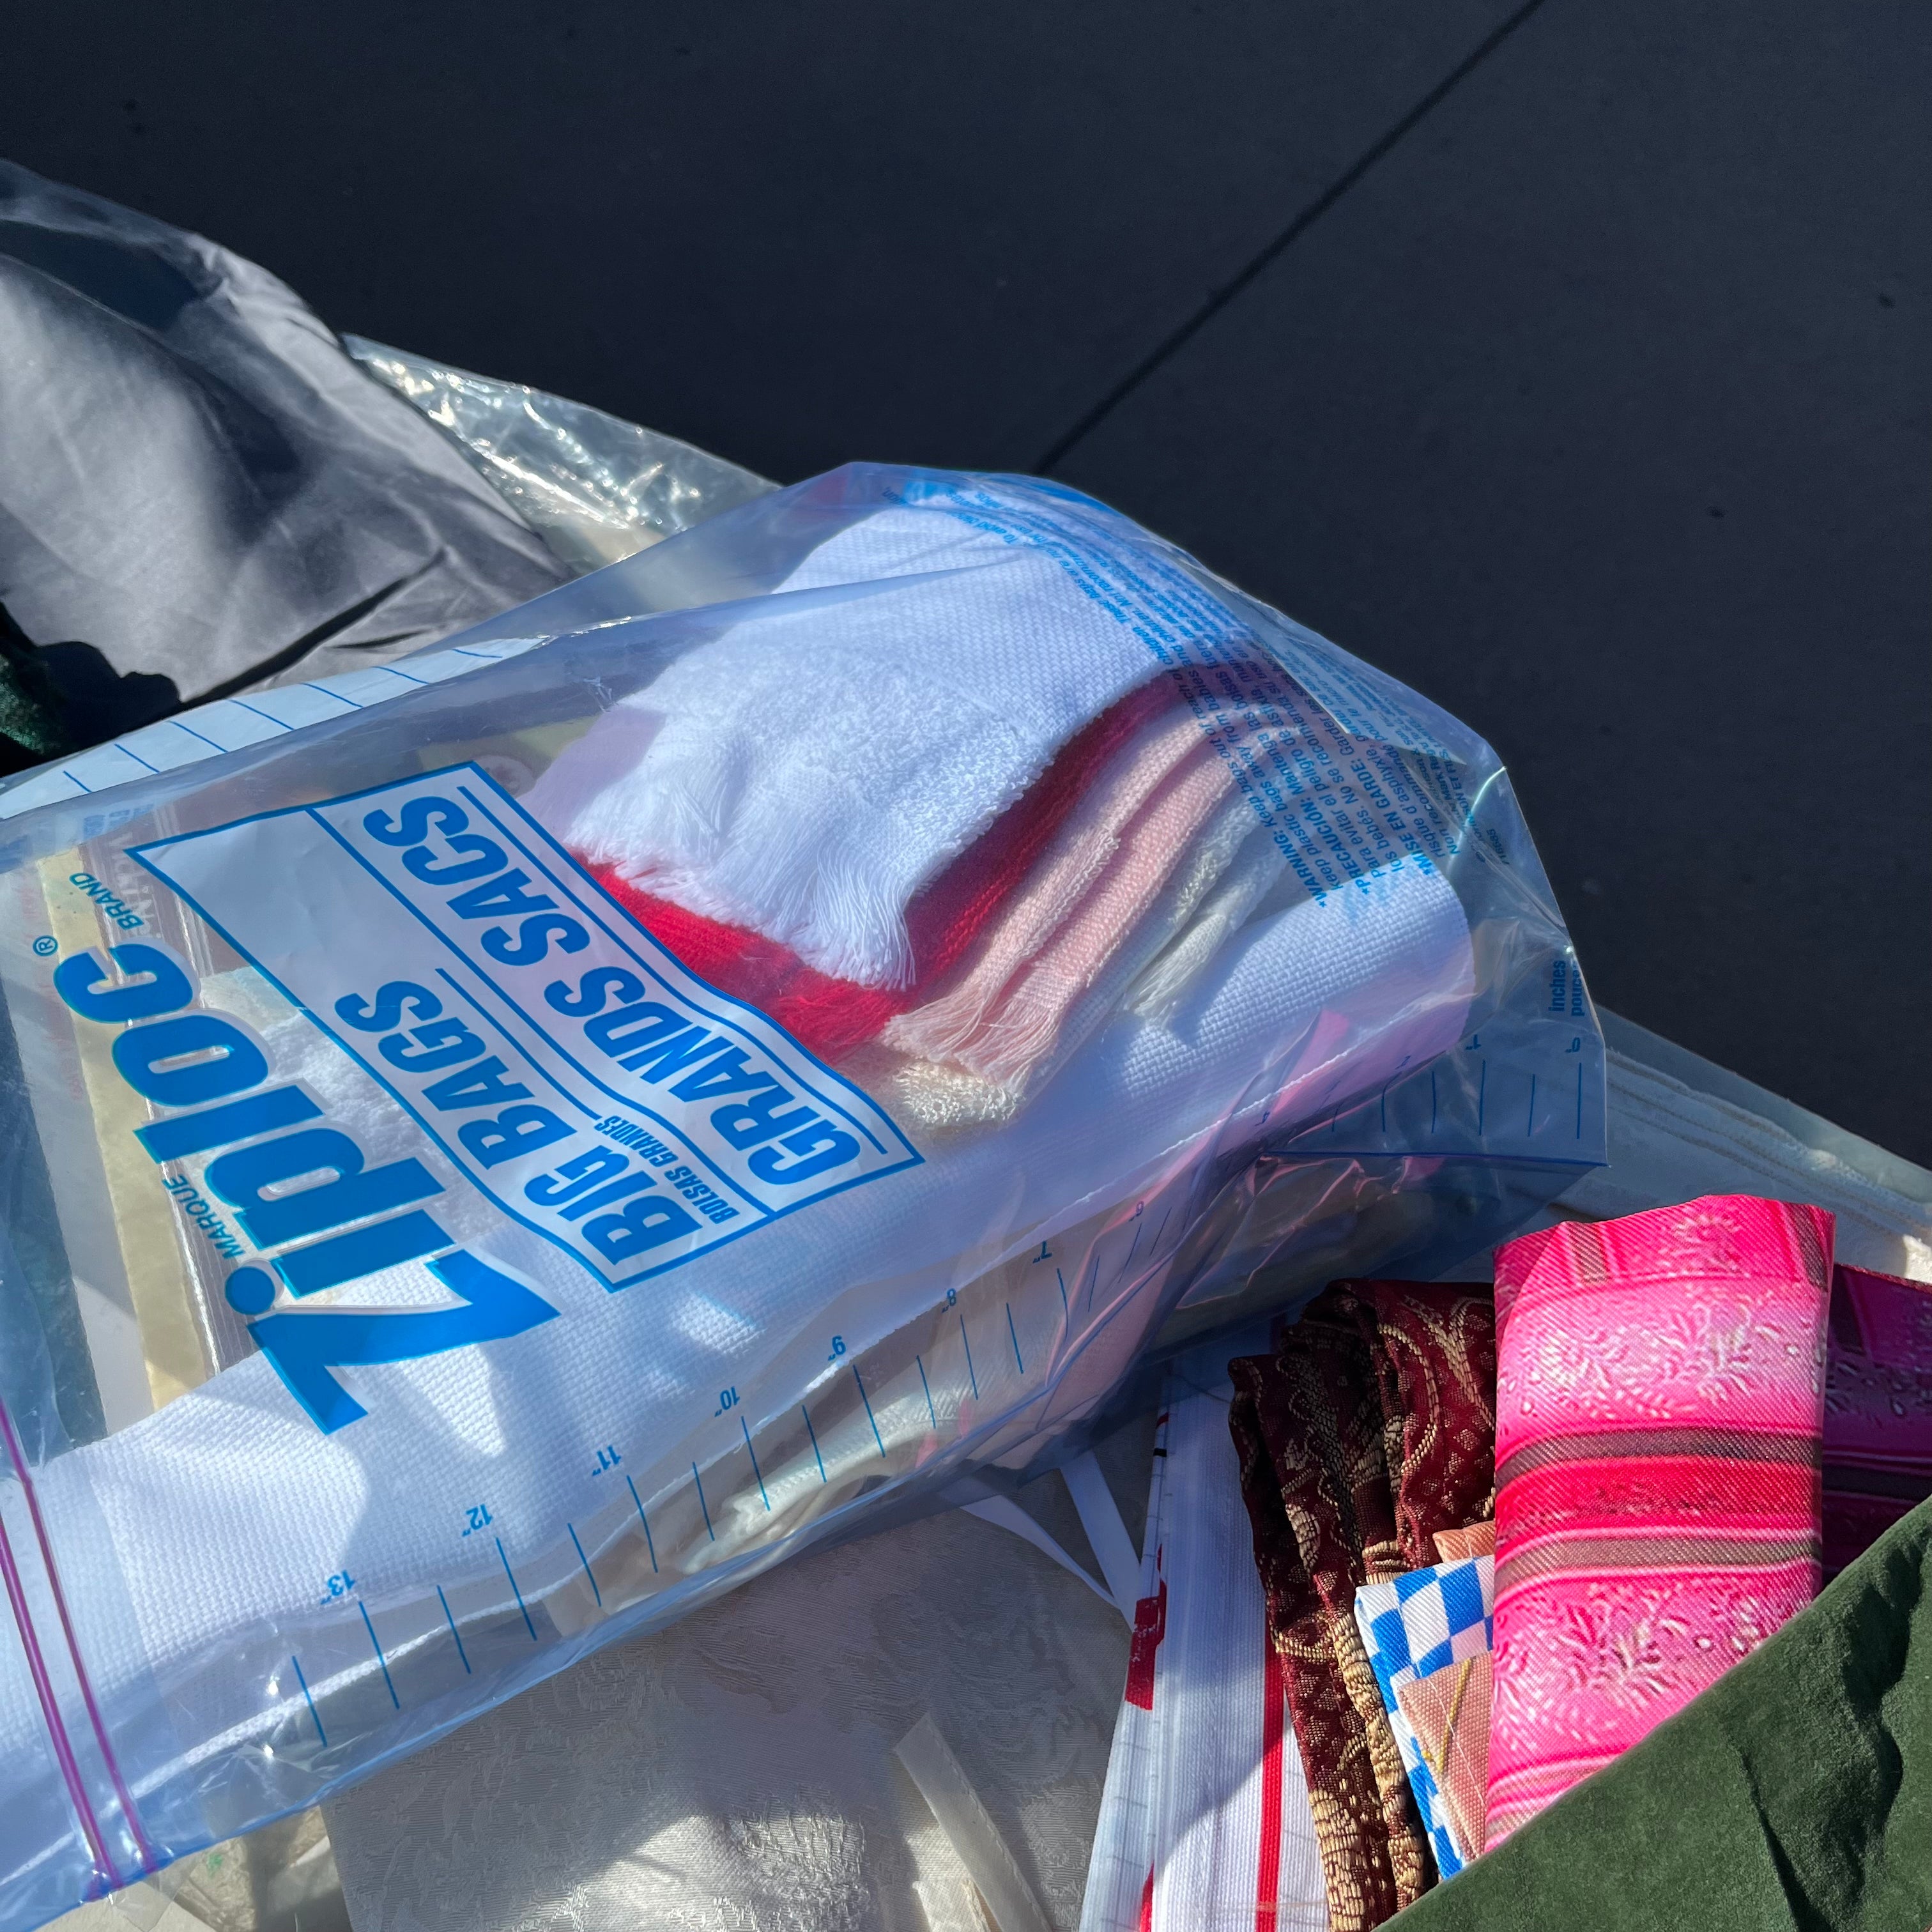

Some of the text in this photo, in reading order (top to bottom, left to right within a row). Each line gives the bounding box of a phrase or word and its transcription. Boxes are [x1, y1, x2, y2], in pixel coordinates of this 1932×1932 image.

[1170, 643, 1194, 666] and
[1165, 670, 1183, 682] of
[1185, 668, 1220, 712] babies
[1215, 670, 1248, 709] bolsas
[1176, 684, 1206, 719] reach
[1199, 722, 1216, 737] of
[1213, 712, 1241, 743] from
[1241, 710, 1262, 732] las
[1276, 694, 1332, 767] recomienda
[1276, 729, 1296, 747] de
[1317, 715, 1354, 756] Garder
[1360, 719, 1387, 739] pour
[1209, 738, 1231, 758] out
[1235, 745, 1264, 779] away
[1256, 732, 1306, 795] Mantenga
[1227, 762, 1254, 793] bags
[1290, 747, 1329, 792] peligro
[1325, 767, 1342, 783] se
[1349, 756, 1391, 808] GARDE:
[1246, 795, 1276, 828] Keep
[1258, 781, 1287, 813] bags
[1318, 793, 1337, 807] el
[1337, 785, 1358, 804] No
[1282, 813, 1320, 856] plastic
[1330, 809, 1363, 843] evitar
[1384, 810, 1406, 831] EN
[1411, 816, 1446, 858] risque
[1437, 827, 1460, 854] Non
[1314, 859, 1344, 891] keep
[1359, 846, 1386, 877] Para
[1384, 850, 1405, 871] los
[363, 795, 590, 967] SACS
[68, 872, 144, 930] BRAND
[1548, 961, 1566, 1011] inches
[543, 966, 861, 1186] GRANDS
[334, 980, 703, 1265] BIG BAGS
[594, 1116, 740, 1224] BOLSAS GRANDES
[54, 942, 561, 1436] Ziploc
[162, 1174, 245, 1261] MARQUE
